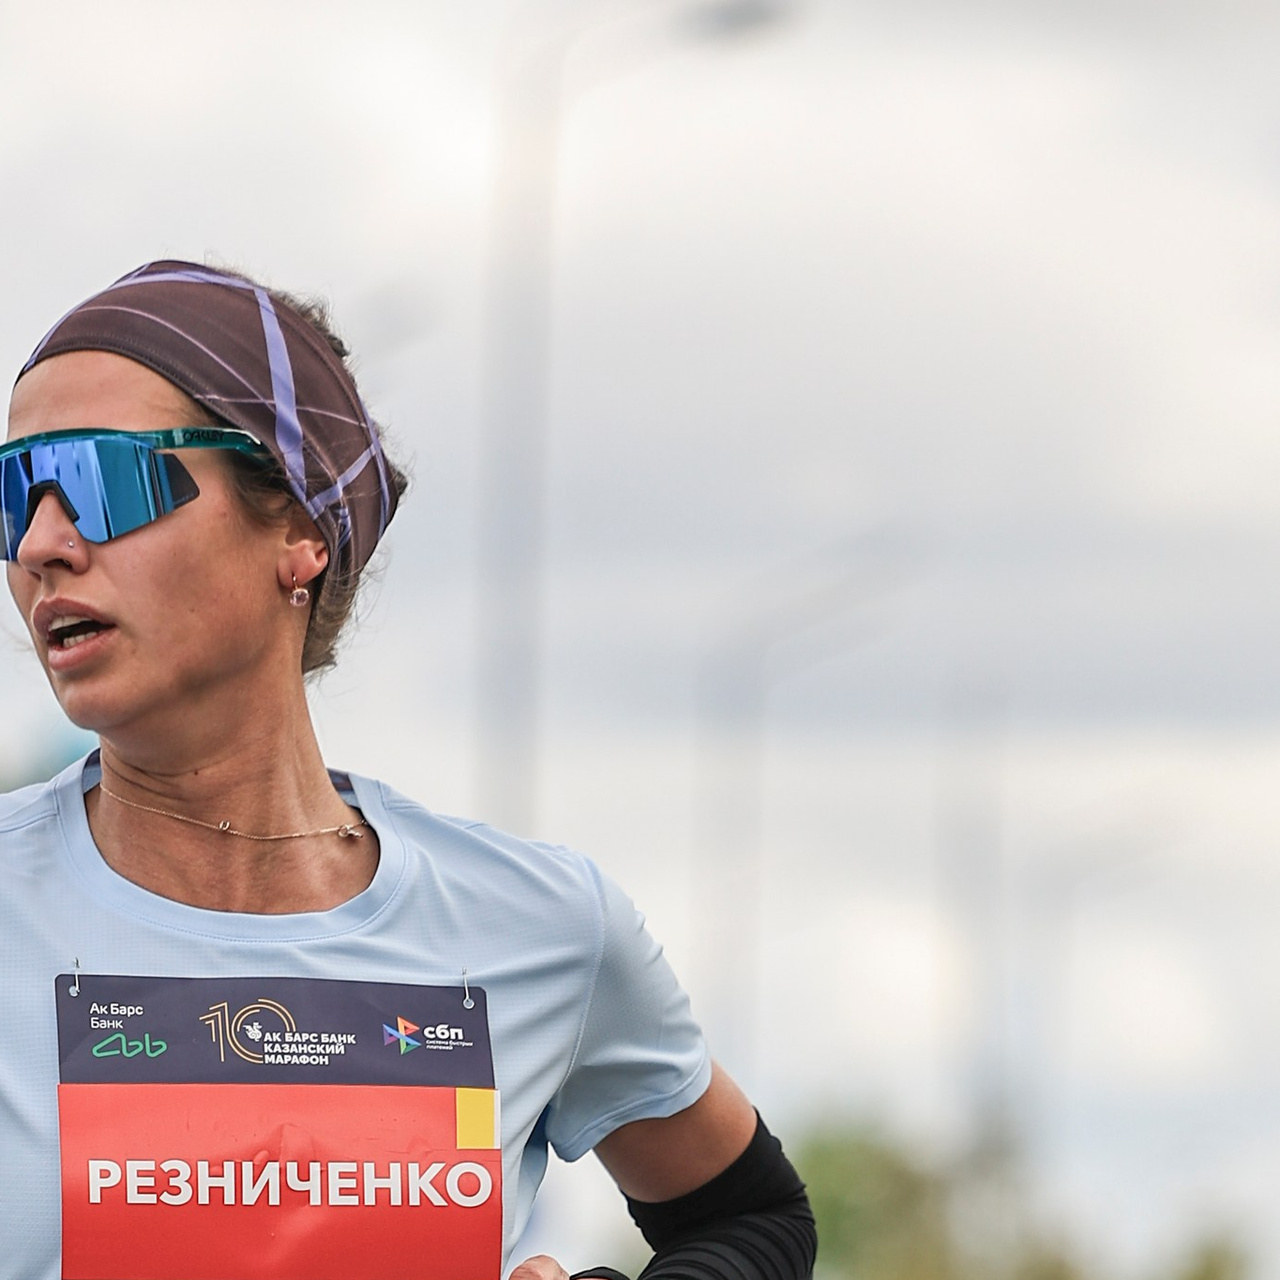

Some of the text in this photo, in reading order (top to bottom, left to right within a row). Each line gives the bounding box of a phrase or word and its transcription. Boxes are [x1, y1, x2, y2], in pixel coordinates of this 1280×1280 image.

[89, 1002, 144, 1018] Ак Барс
[90, 1016, 124, 1029] Банк
[263, 1032, 357, 1045] АК БАРС БАНК
[263, 1043, 346, 1055] КАЗАНСКИЙ
[264, 1054, 330, 1065] МАРАФОН
[87, 1158, 494, 1208] РЕЗНИЧЕНКО
